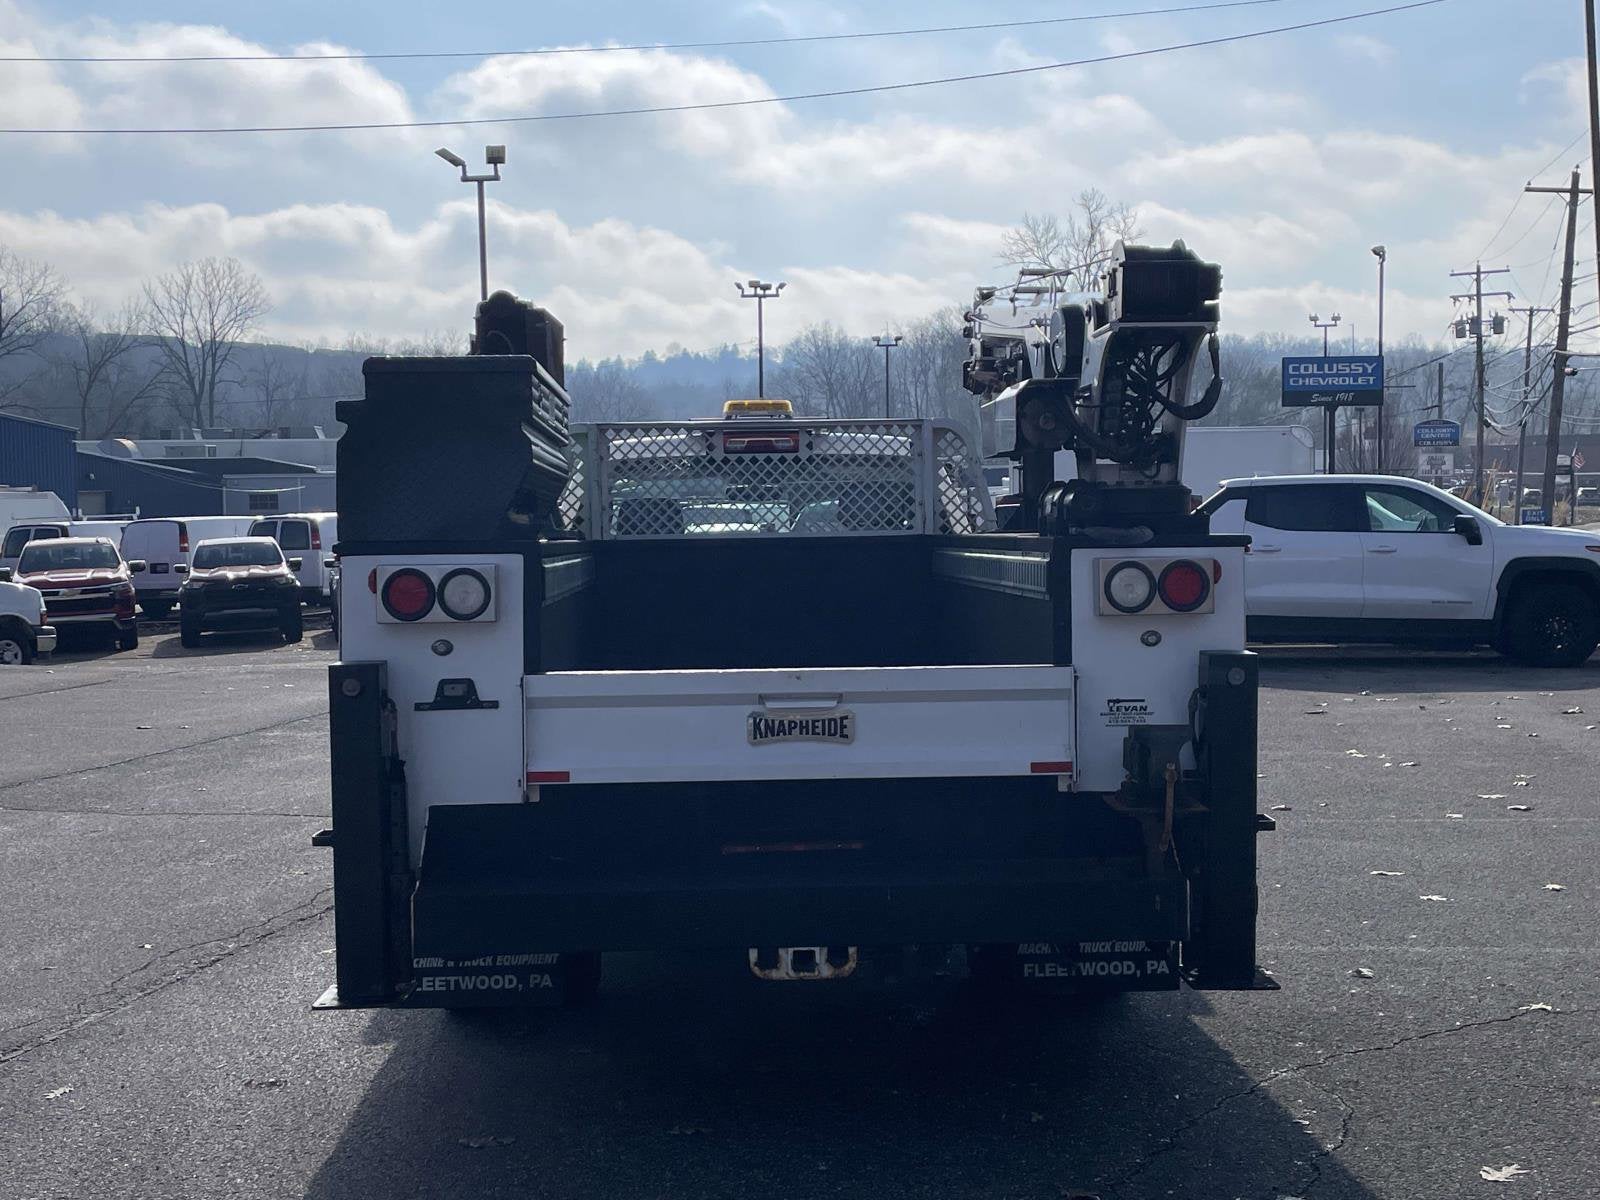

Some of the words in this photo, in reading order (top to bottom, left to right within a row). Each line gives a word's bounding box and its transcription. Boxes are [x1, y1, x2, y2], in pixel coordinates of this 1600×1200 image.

[1288, 362, 1377, 375] COLUSSY
[1289, 376, 1376, 386] CHEVROLET
[1310, 393, 1333, 403] Since
[1335, 392, 1355, 402] 1918
[752, 714, 849, 740] KNAPHEIDE
[1079, 941, 1113, 953] TRUCK
[413, 957, 444, 968] CHINE
[495, 953, 560, 966] EQUIPMENT
[1023, 961, 1141, 978] FLEEWOOD,
[1146, 959, 1170, 975] PA
[416, 974, 523, 992] EETWOOD,
[529, 973, 553, 989] PA
